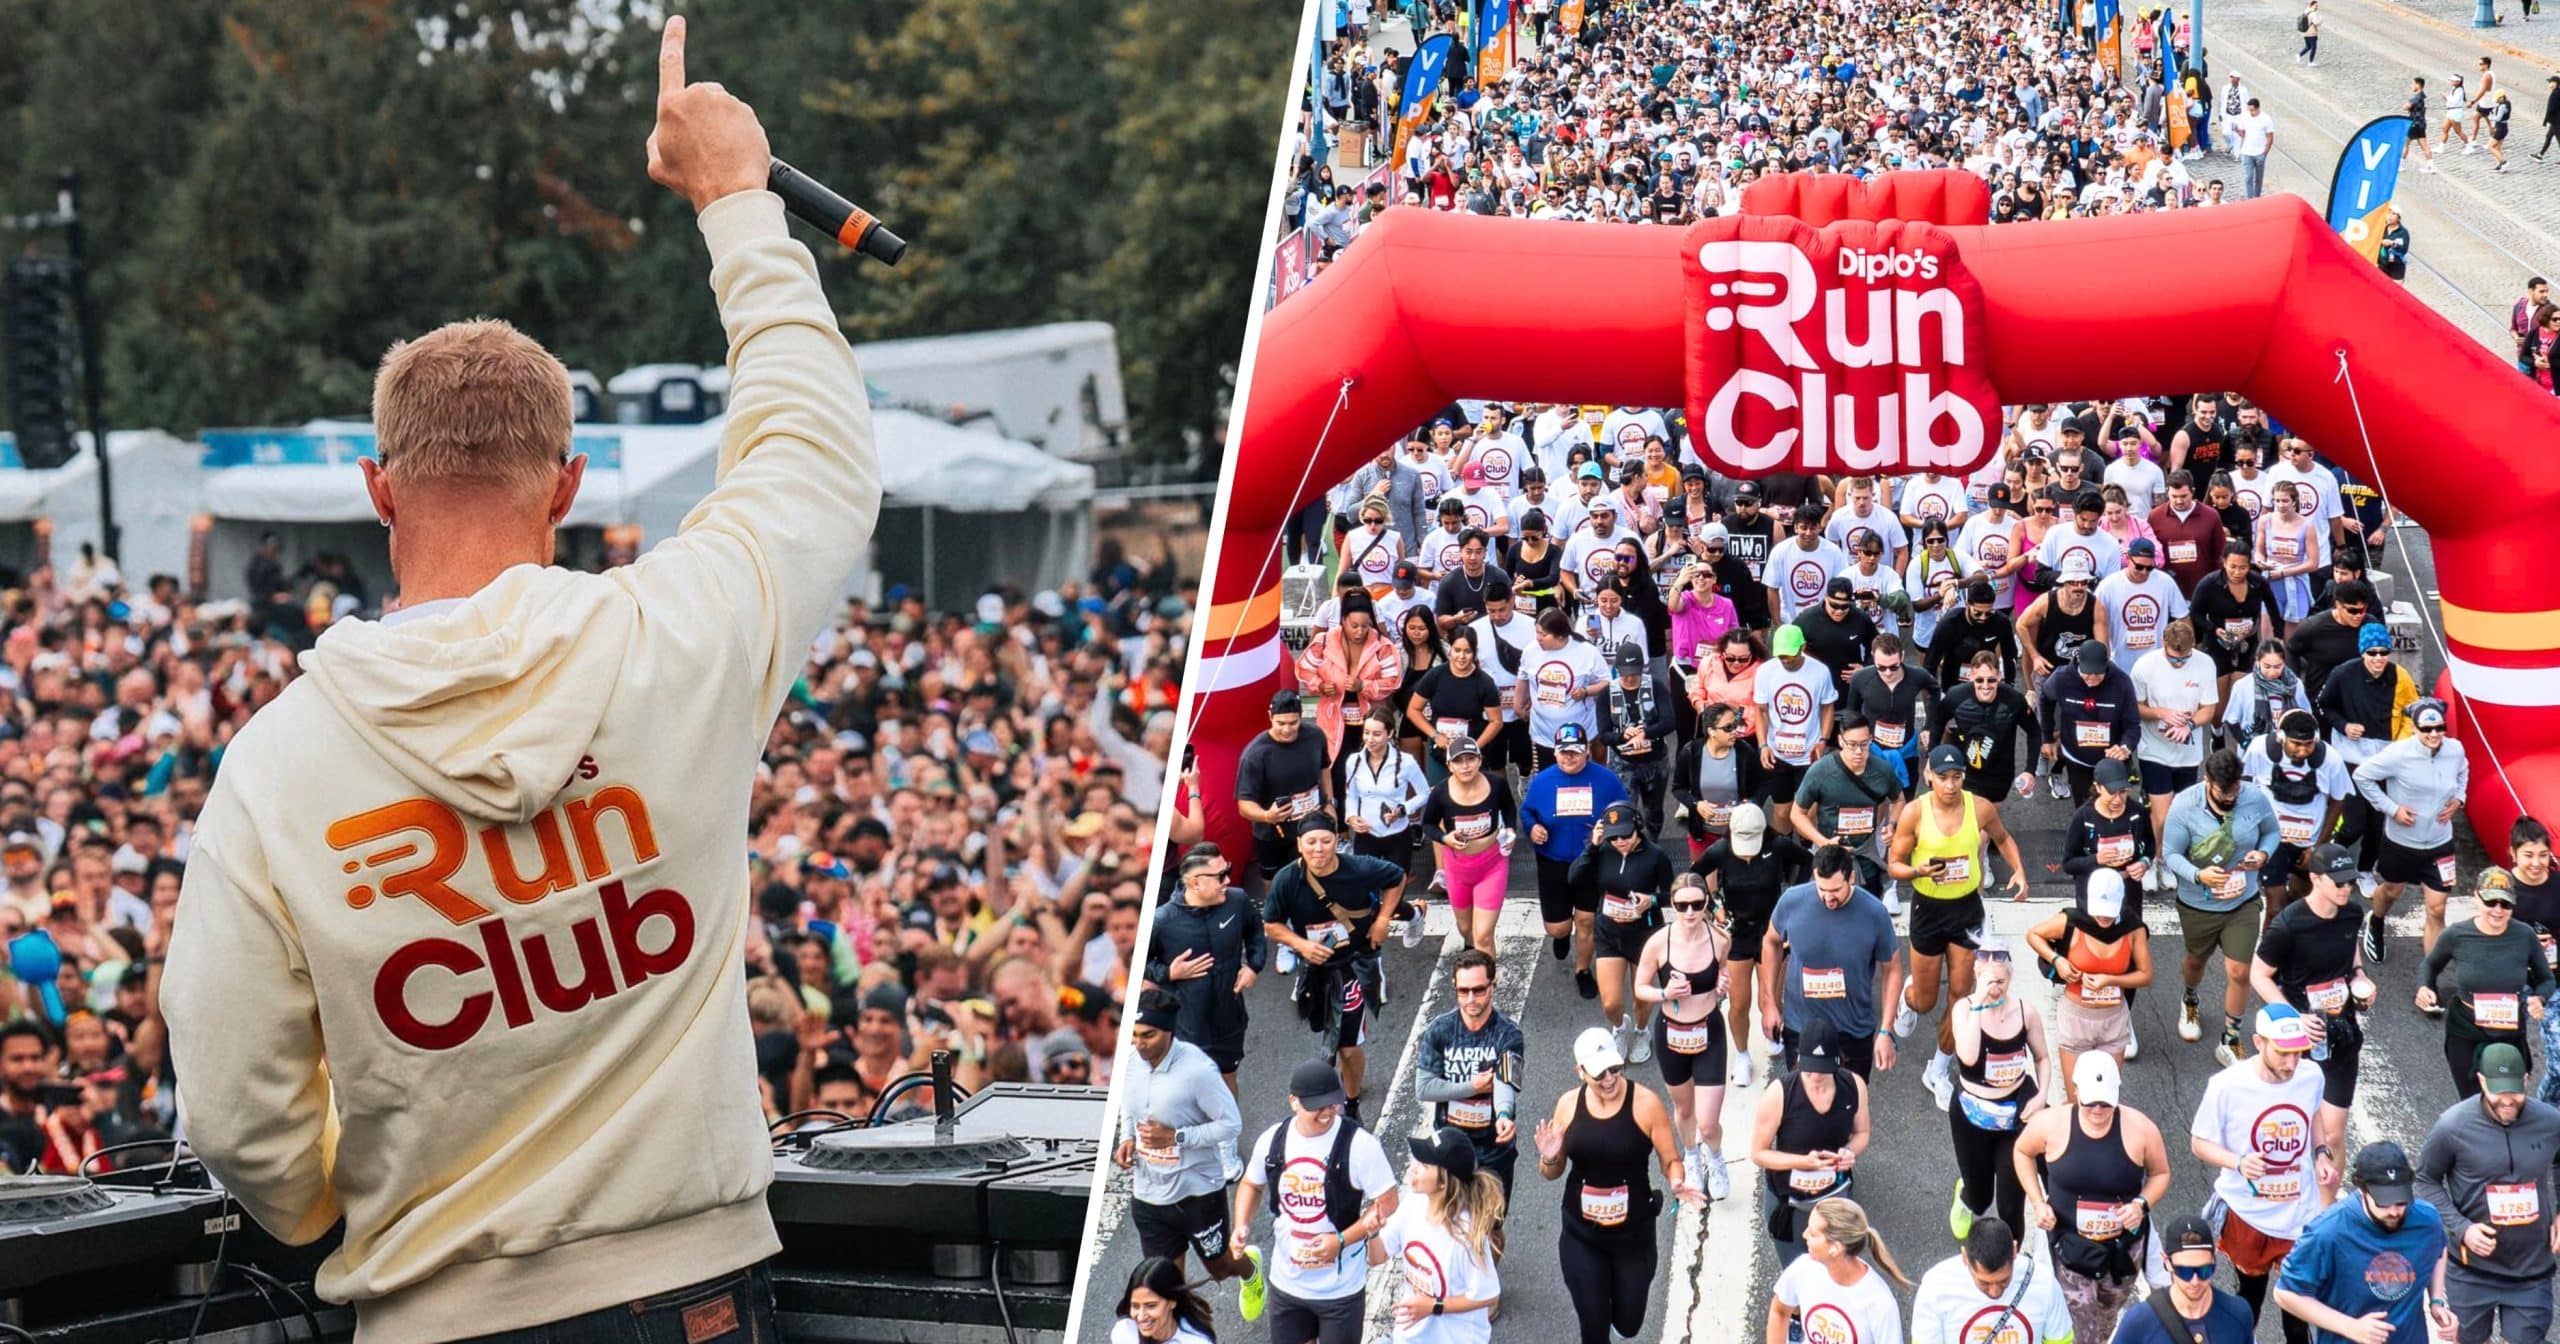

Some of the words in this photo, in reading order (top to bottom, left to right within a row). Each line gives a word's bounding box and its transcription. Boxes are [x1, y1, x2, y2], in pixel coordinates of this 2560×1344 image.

[1407, 49, 1438, 121] VIP
[2344, 138, 2391, 244] VIP
[1838, 247, 1939, 285] Diplo's
[1699, 240, 1965, 370] Run
[1705, 367, 1985, 471] Club
[1485, 465, 1508, 475] Club
[1731, 536, 1762, 557] nWo
[1983, 552, 2007, 562] Club
[1797, 570, 1819, 581] Run
[1796, 580, 1820, 591] Club
[2129, 604, 2153, 615] Run
[2129, 614, 2155, 625] Club
[1542, 670, 1566, 682] Run
[1781, 693, 1804, 705] Run
[1781, 704, 1806, 717] Club
[326, 784, 662, 926] Run
[373, 879, 695, 1051] Club
[1444, 1046, 1498, 1061] MARINA
[2261, 1121, 2300, 1139] Run
[2261, 1138, 2301, 1154] Club
[1283, 1174, 1326, 1194] Run
[1284, 1192, 1327, 1208] Club
[1814, 1314, 1846, 1343] Run
